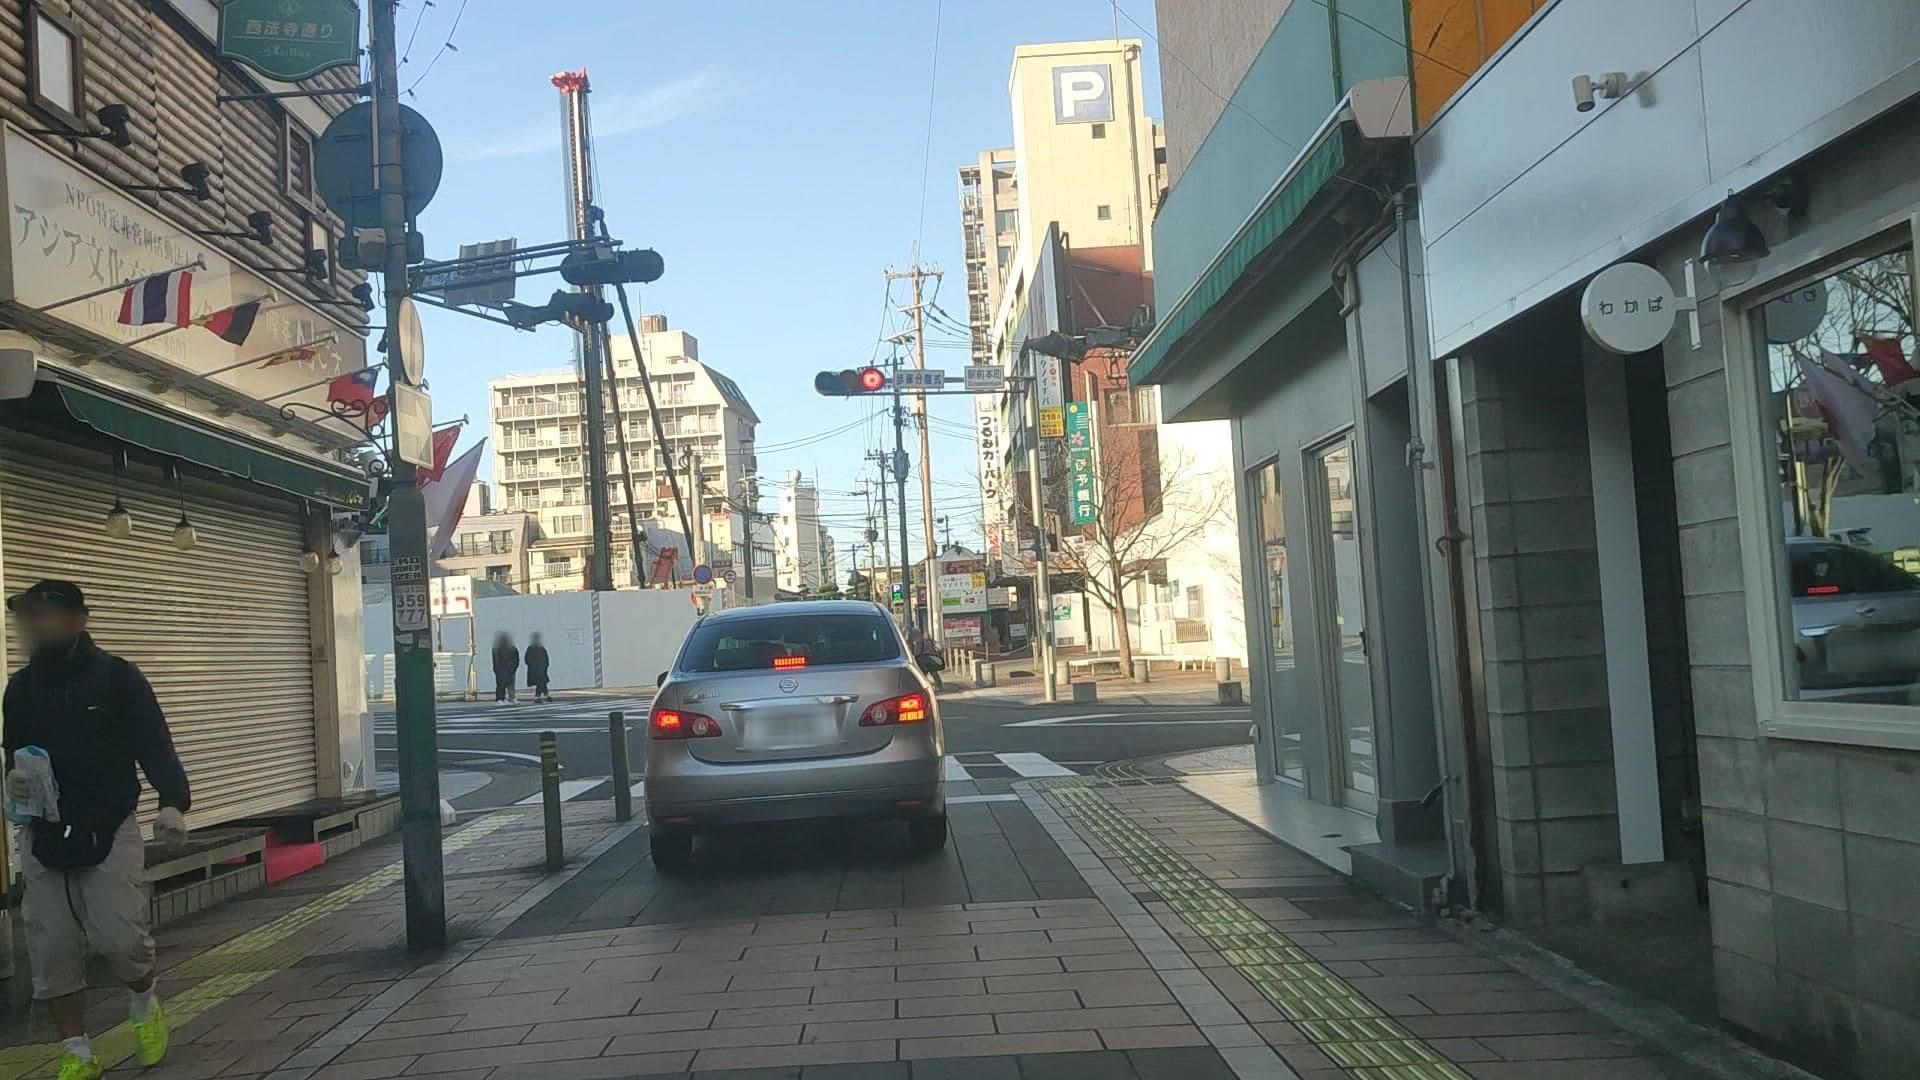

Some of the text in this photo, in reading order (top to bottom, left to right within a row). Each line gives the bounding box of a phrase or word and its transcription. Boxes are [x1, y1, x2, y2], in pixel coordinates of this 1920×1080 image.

[246, 19, 333, 38] 西法寺通り
[1060, 71, 1105, 118] P
[980, 415, 997, 500] つるみカーパーク
[396, 594, 426, 608] 359
[397, 607, 426, 622] 777
